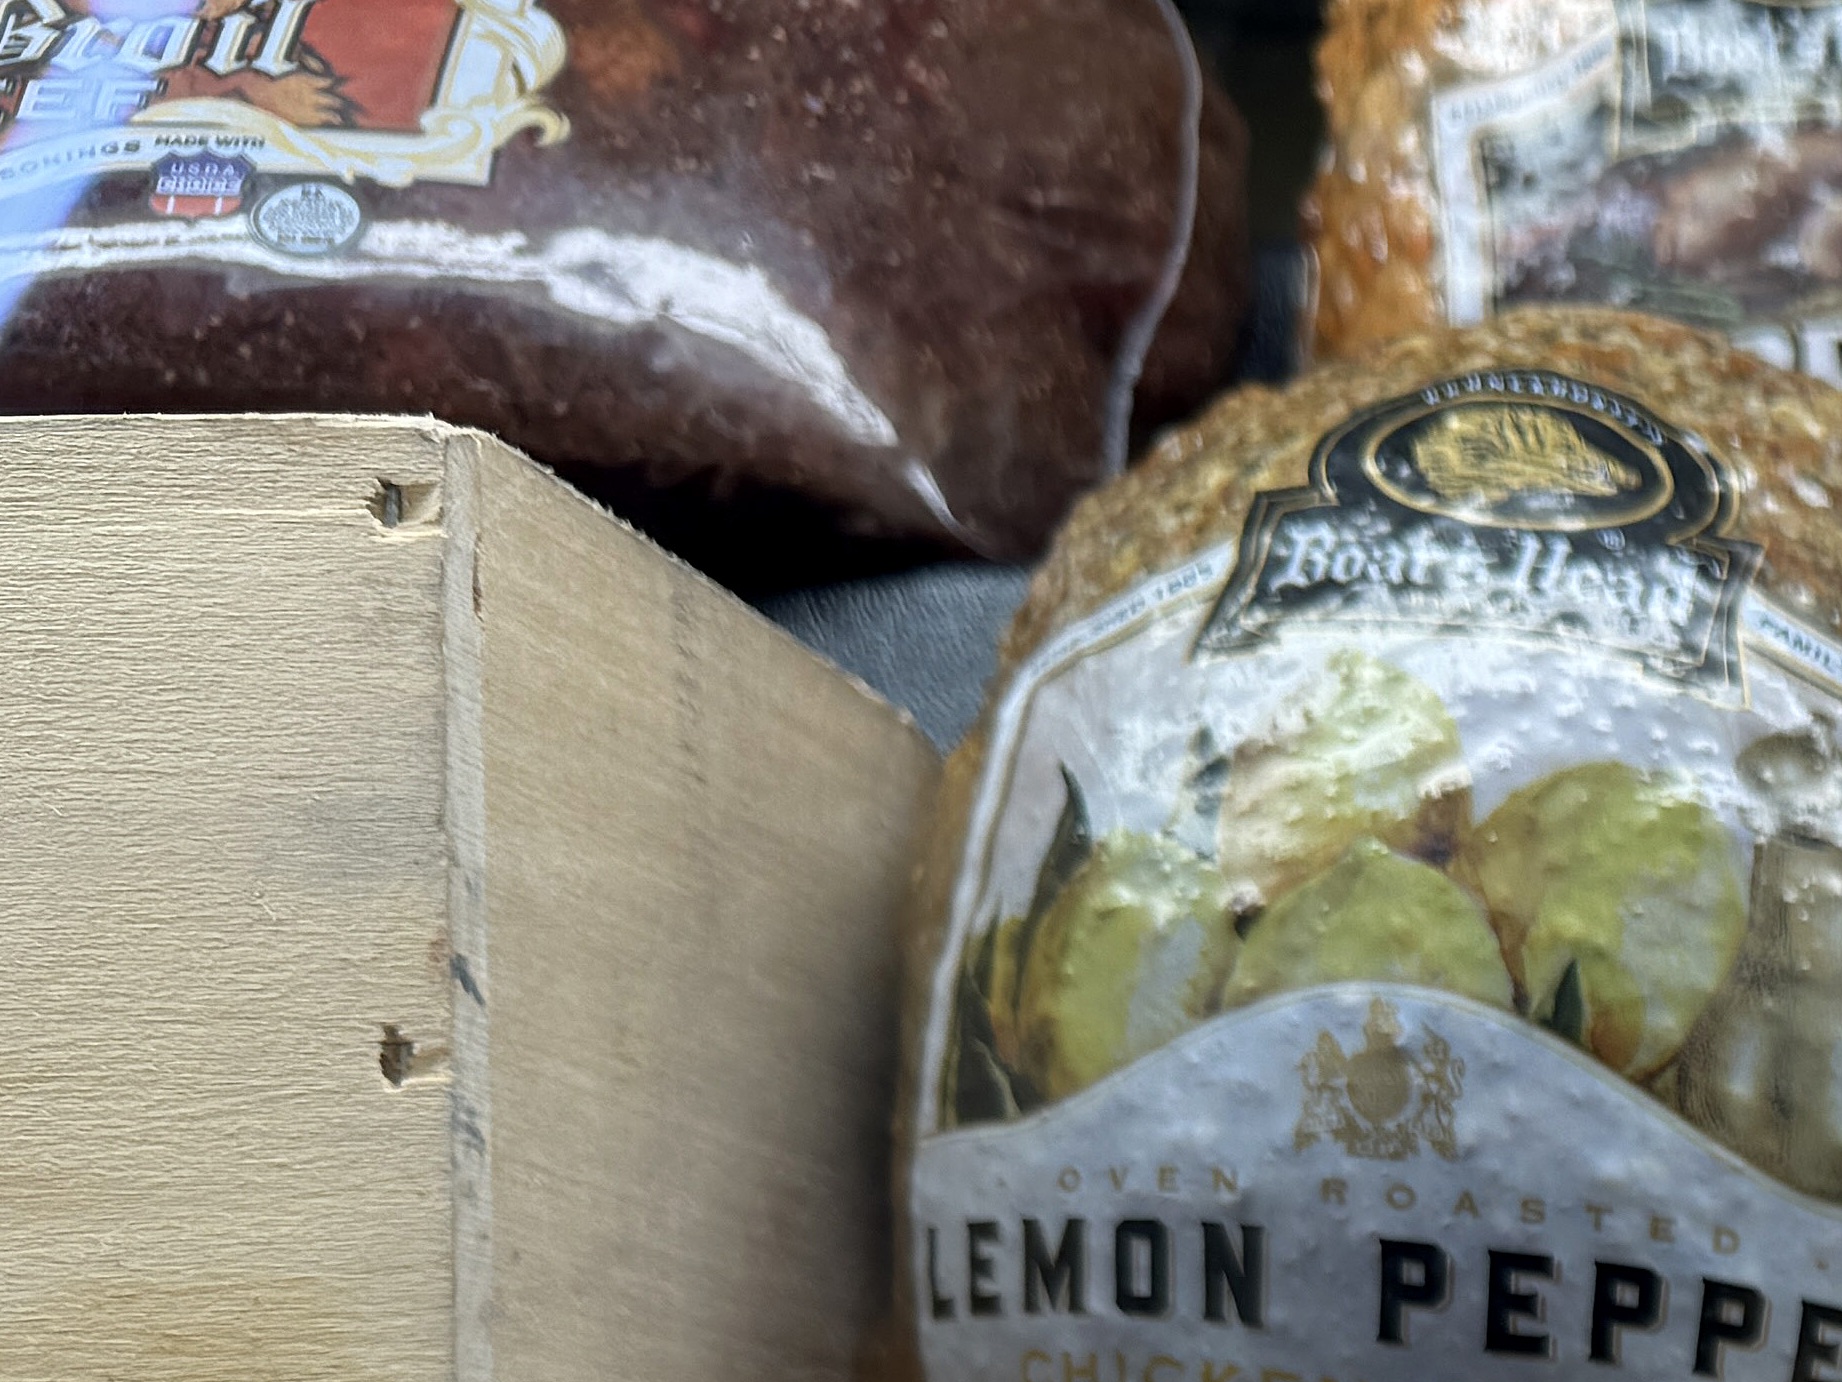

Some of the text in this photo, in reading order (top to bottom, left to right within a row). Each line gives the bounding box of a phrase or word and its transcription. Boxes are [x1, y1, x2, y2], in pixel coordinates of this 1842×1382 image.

[155, 136, 207, 149] MADE
[1058, 1165, 1742, 1257] OVEN ROASTED
[925, 1217, 1268, 1330] LEMON
